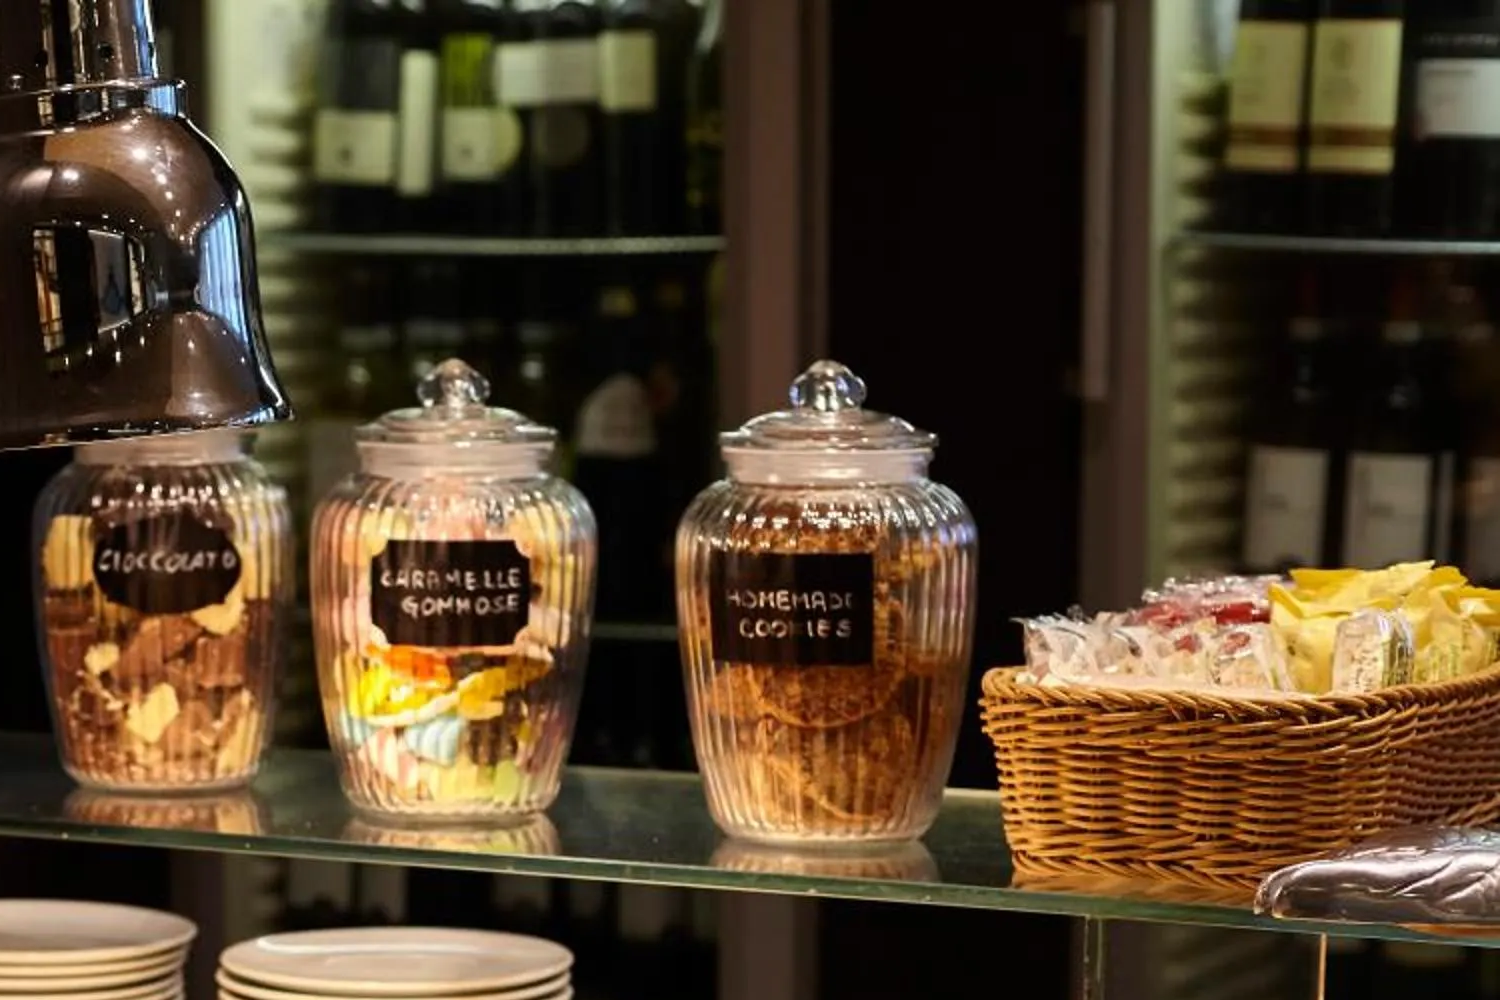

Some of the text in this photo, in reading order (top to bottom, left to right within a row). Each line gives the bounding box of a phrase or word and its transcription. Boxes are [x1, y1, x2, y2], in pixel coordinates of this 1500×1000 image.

[98, 549, 237, 574] CIOCCOLATO
[380, 568, 522, 591] CARAMELLE
[401, 594, 520, 621] GOMMOSE
[739, 617, 852, 638] COOIES
